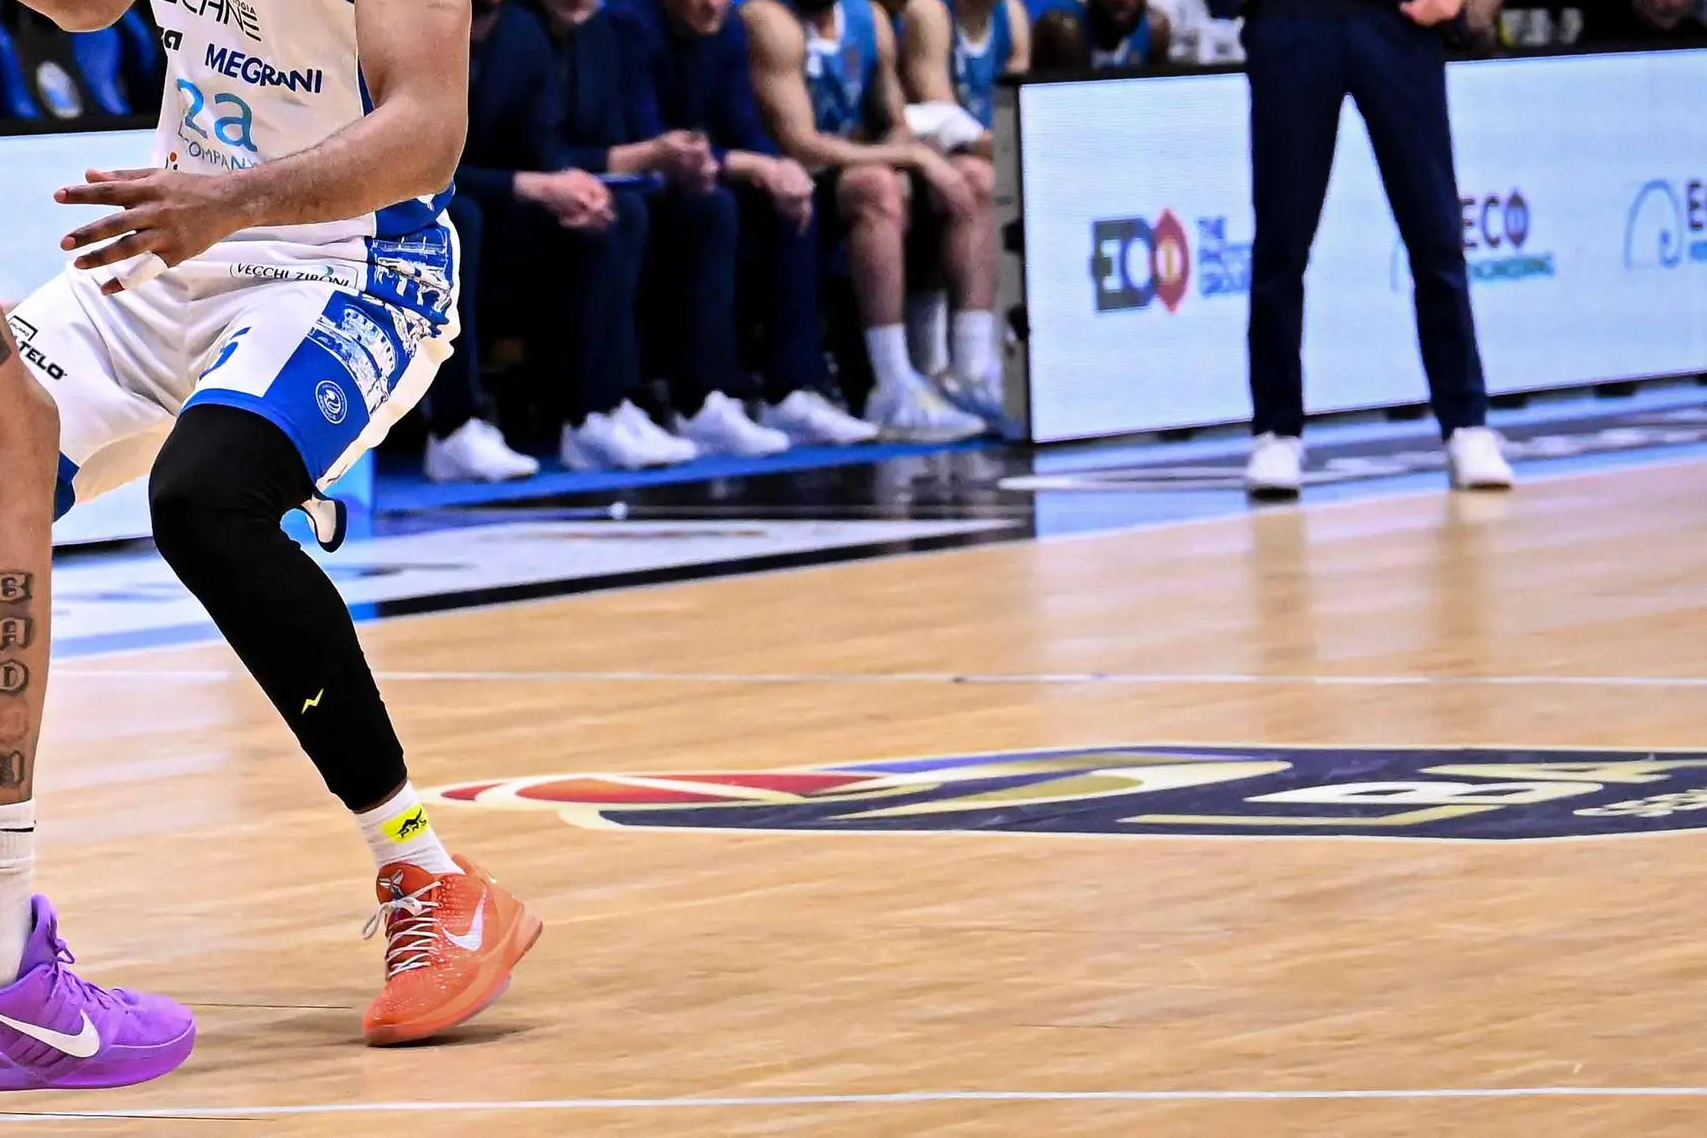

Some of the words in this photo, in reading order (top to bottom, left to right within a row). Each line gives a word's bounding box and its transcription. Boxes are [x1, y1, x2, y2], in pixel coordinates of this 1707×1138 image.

[204, 43, 323, 94] MEGRANI
[175, 77, 258, 153] 2a
[236, 262, 290, 279] VECCHI
